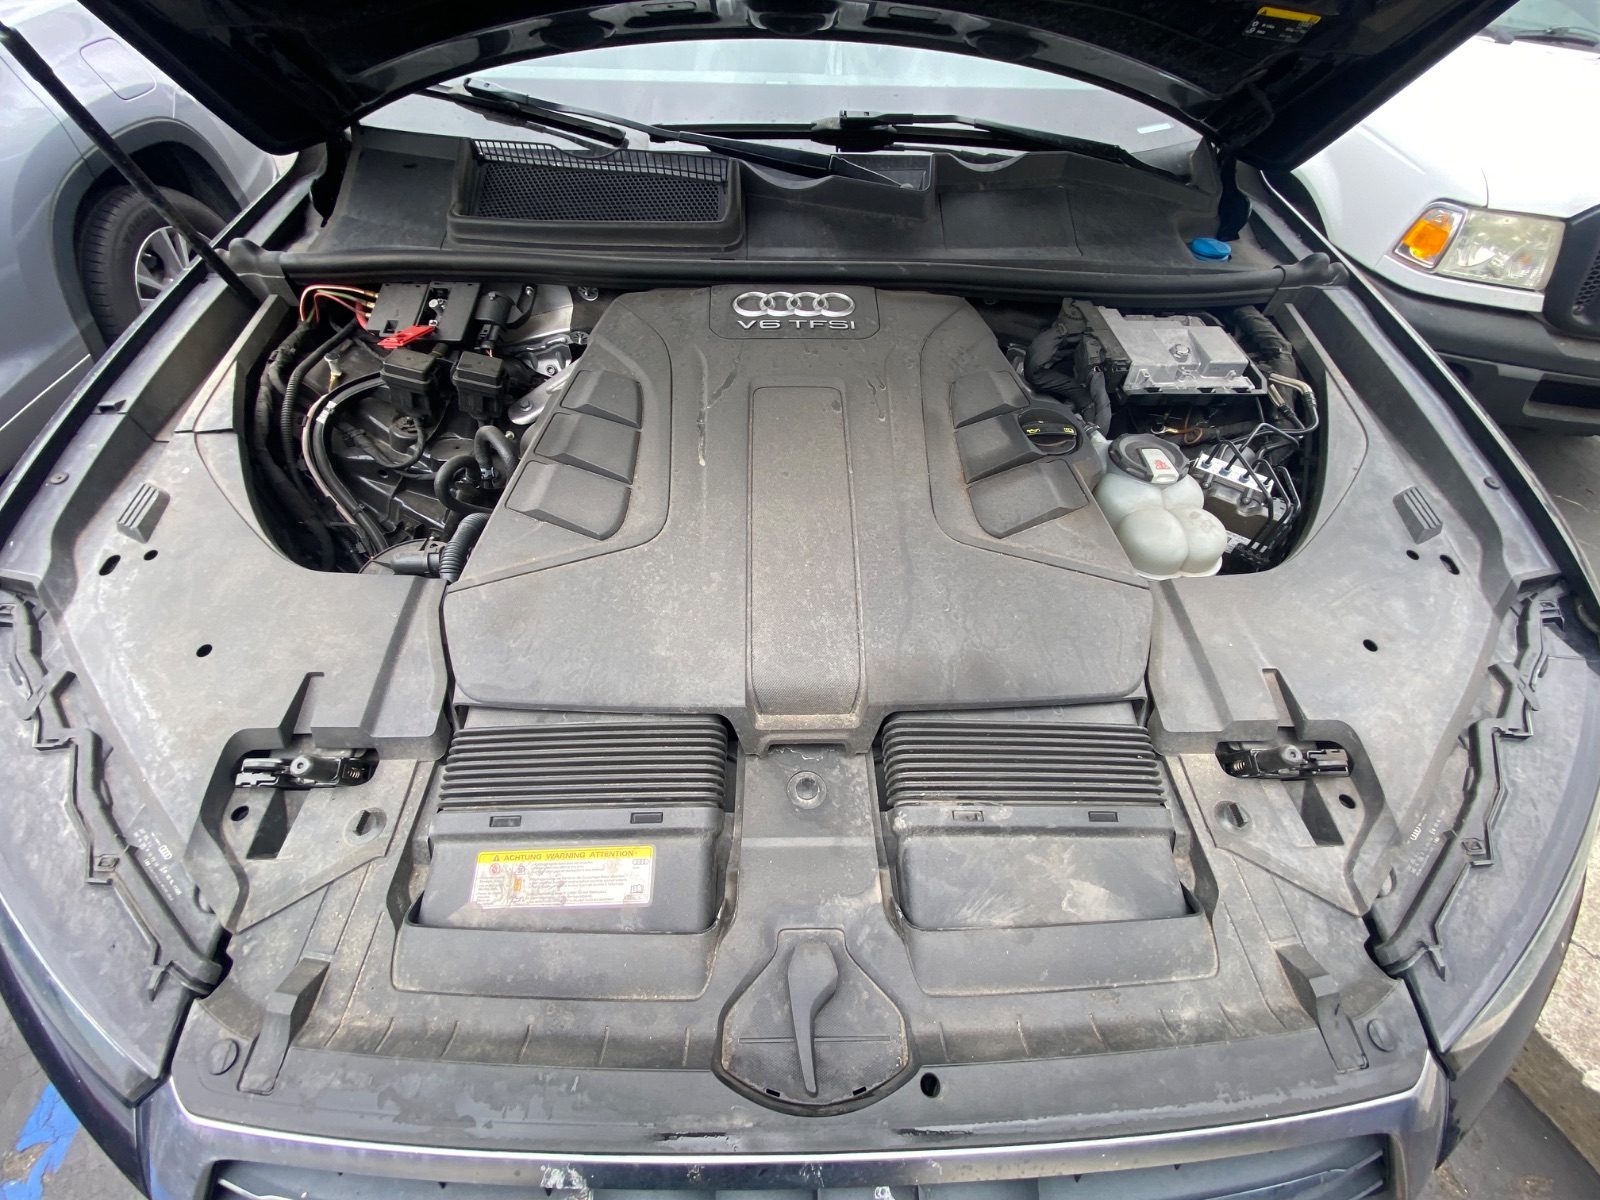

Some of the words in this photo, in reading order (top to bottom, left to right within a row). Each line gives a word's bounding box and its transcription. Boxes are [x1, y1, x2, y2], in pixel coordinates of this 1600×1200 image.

[737, 320, 781, 330] V6
[788, 320, 856, 330] TFSI
[503, 853, 543, 862] ACHTUNG
[546, 851, 586, 860] WARNING
[589, 850, 634, 859] ATTENTION
